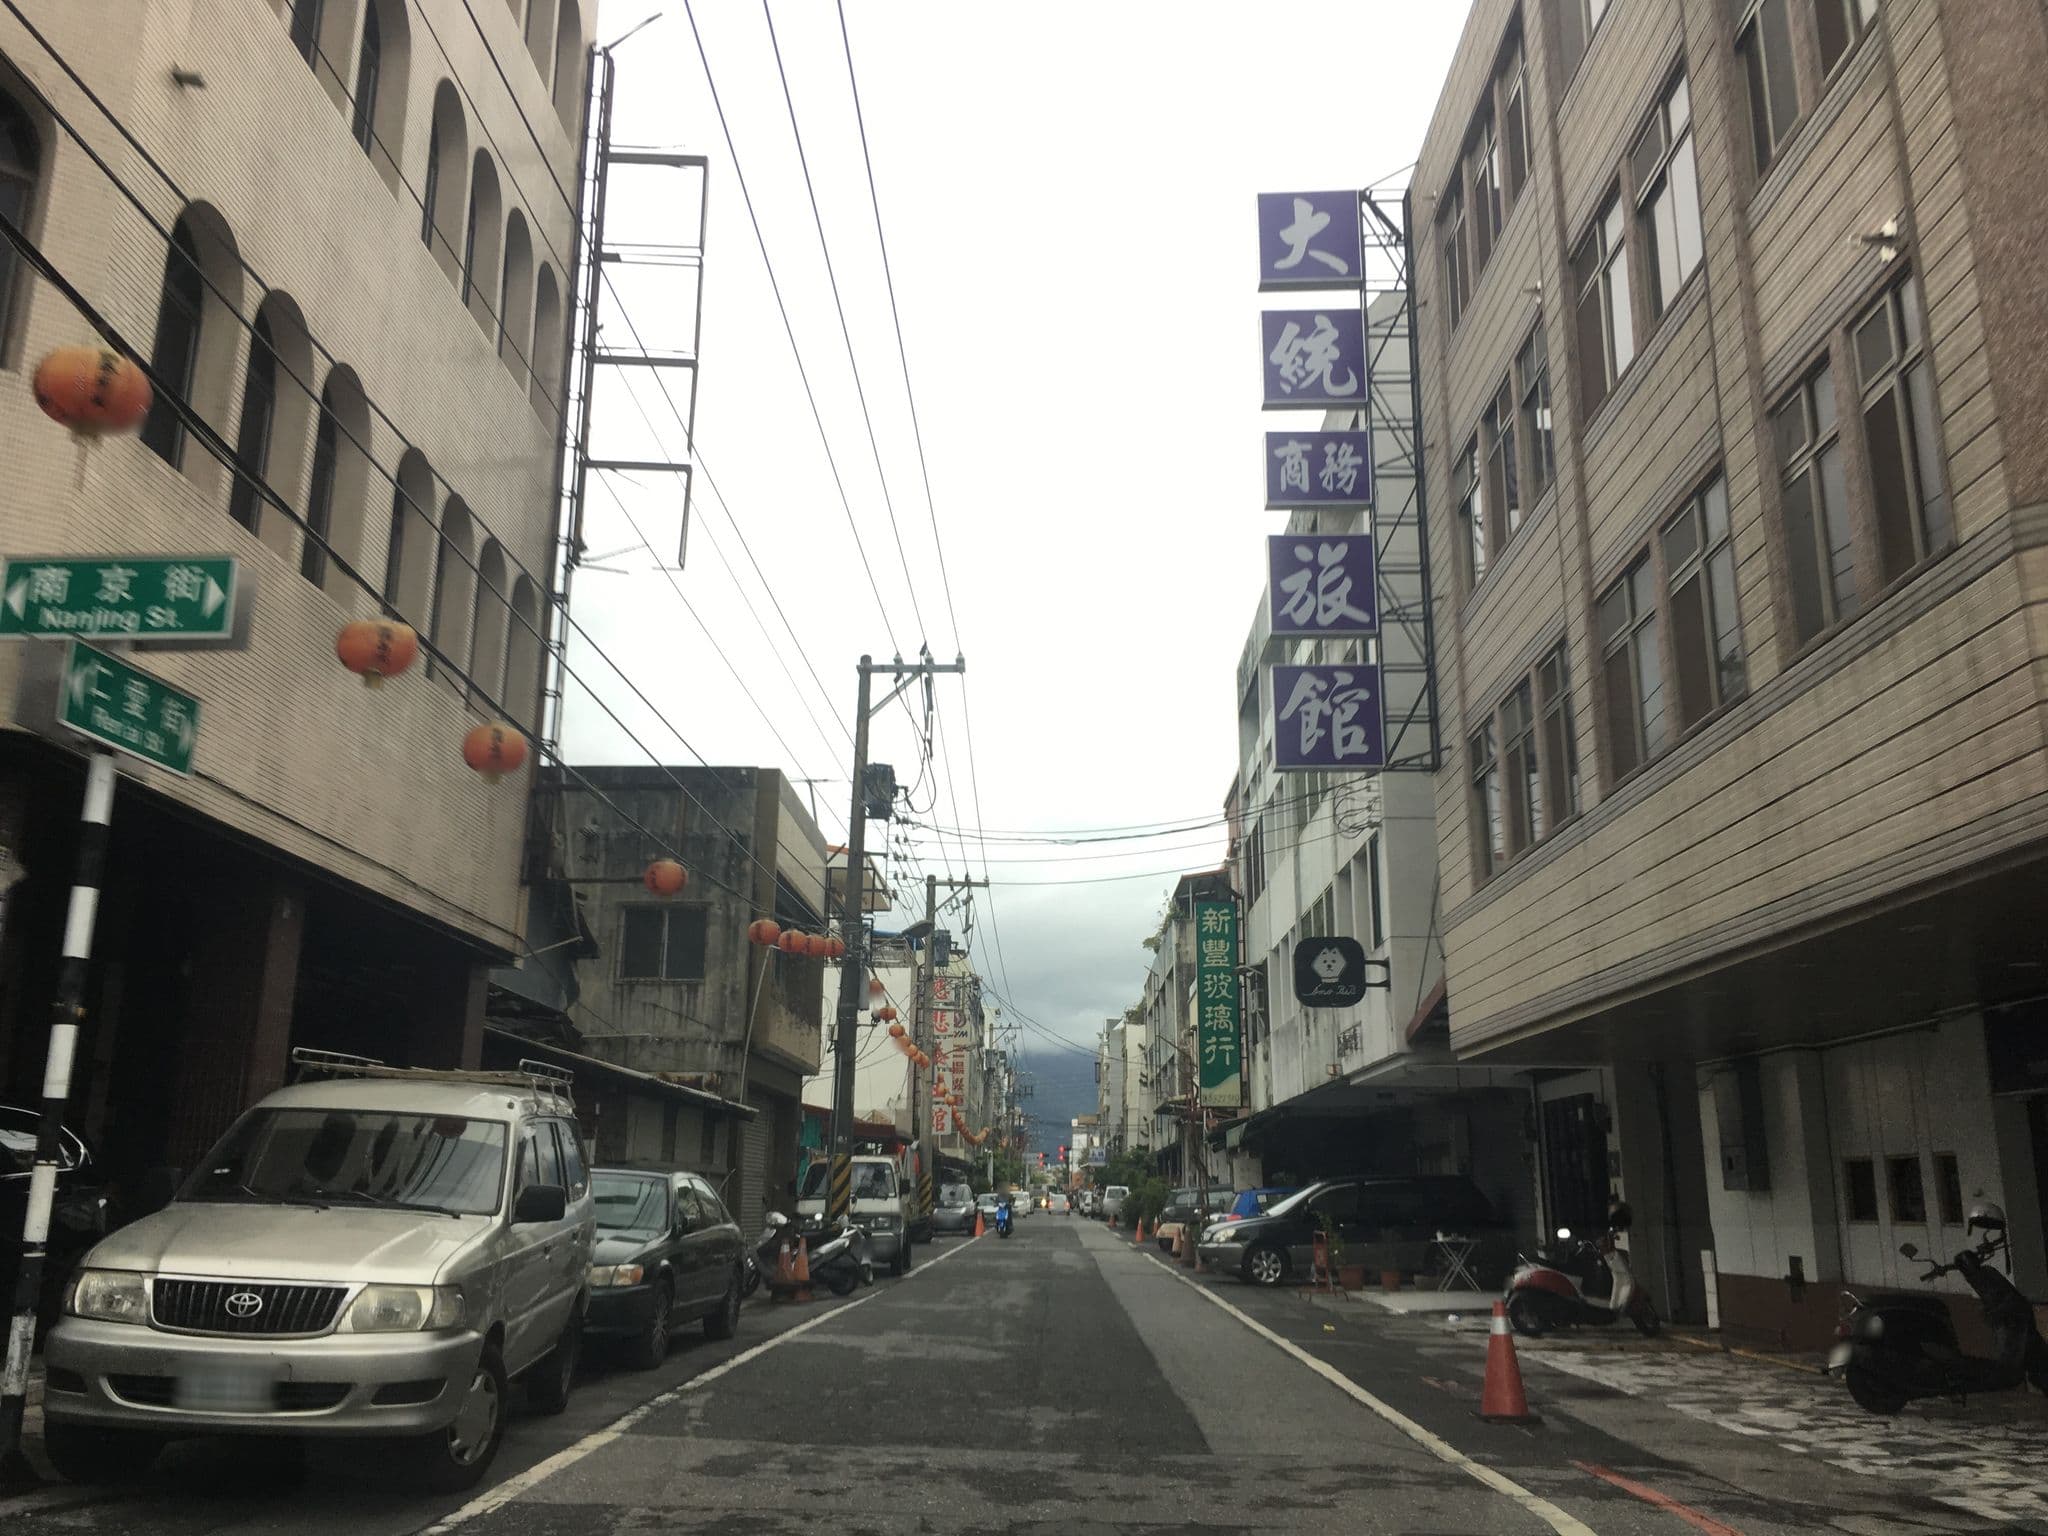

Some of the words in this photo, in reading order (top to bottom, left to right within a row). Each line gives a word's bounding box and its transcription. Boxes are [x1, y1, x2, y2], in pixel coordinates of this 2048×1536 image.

[1270, 198, 1370, 759] 大統商務旅館
[28, 563, 203, 603] 南京街
[38, 606, 140, 632] Nanjing
[144, 605, 184, 628] St.
[1202, 907, 1235, 1066] 新豐玻璃行
